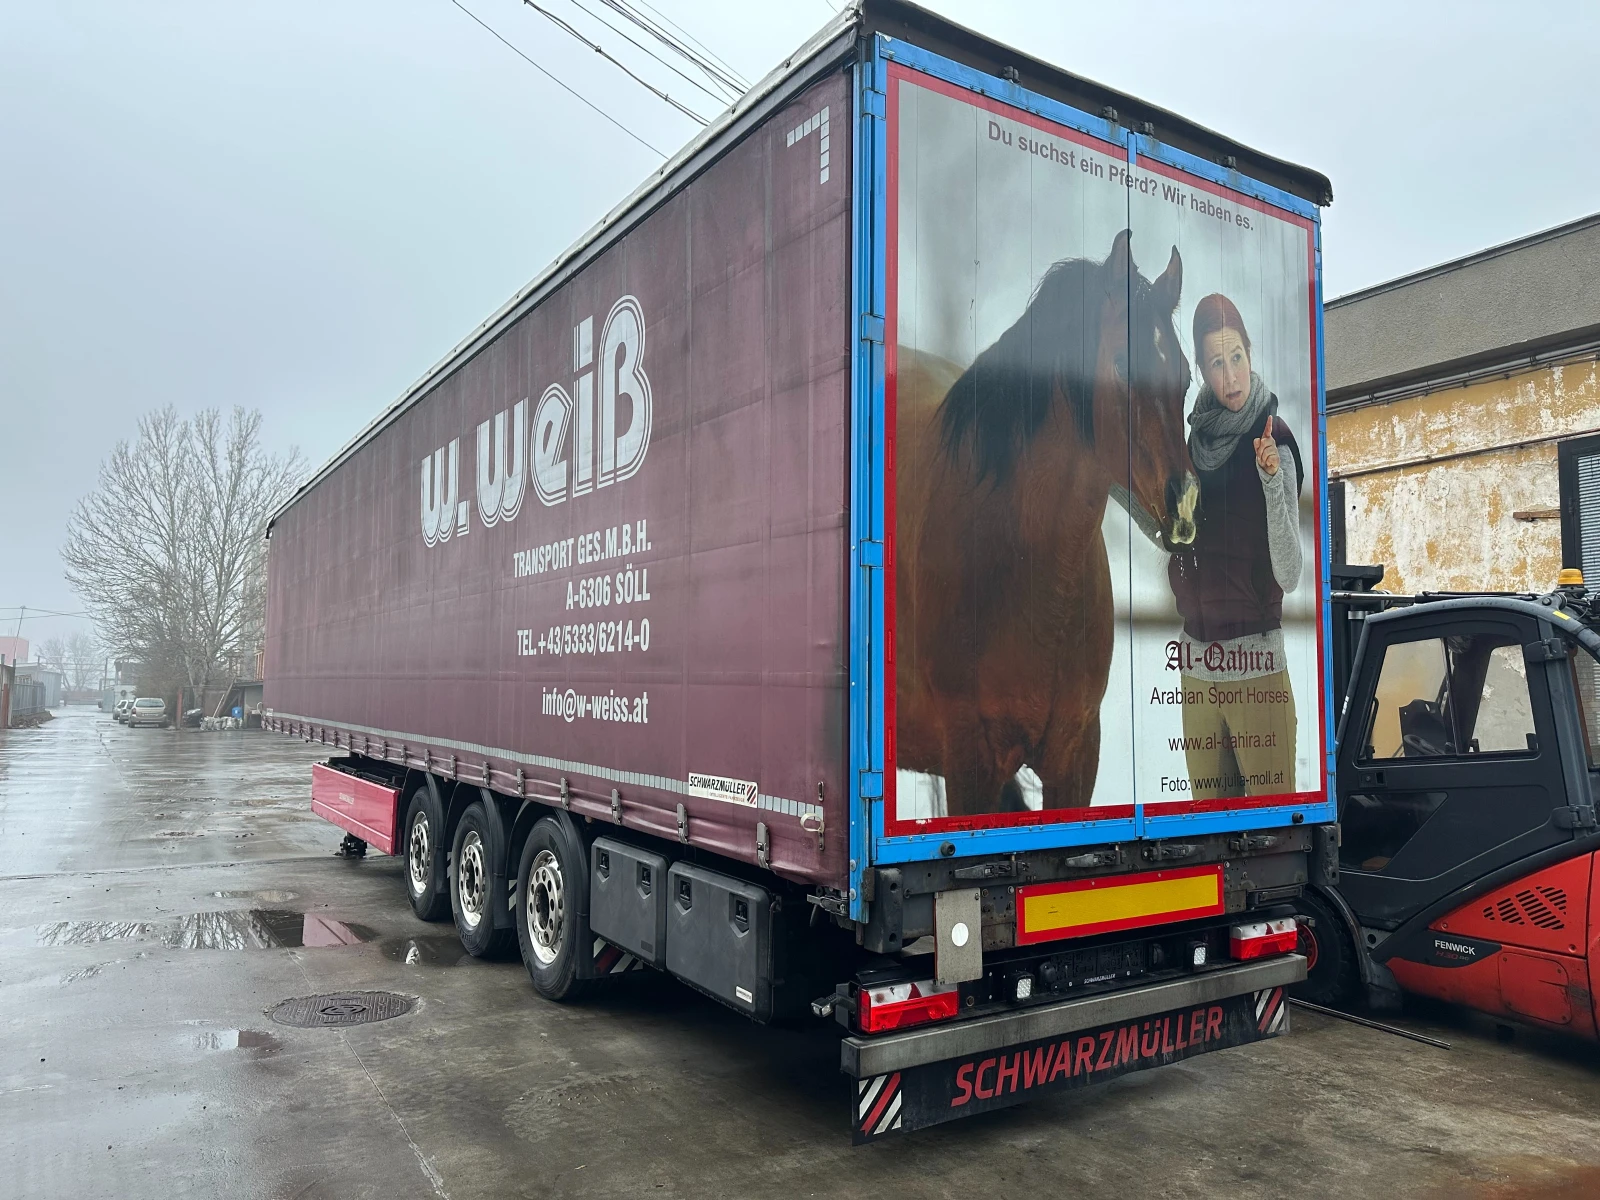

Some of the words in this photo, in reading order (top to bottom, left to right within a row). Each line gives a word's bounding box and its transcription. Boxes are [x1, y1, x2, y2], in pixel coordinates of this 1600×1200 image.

[988, 120, 1012, 146] Du
[1018, 135, 1075, 169] suchst
[1080, 157, 1104, 178] ein
[1109, 165, 1158, 196] Pferd?
[1162, 183, 1187, 206] Wir
[1191, 193, 1231, 223] haben
[1235, 212, 1254, 231] es.
[513, 538, 574, 578] TRANSPORT
[577, 519, 652, 565] GES.M.B.H.
[566, 575, 611, 610] A-6306
[615, 563, 651, 605] SÖLL
[1165, 640, 1275, 676] Al-Qahira
[542, 687, 648, 723] info@w-weiss.at
[1150, 687, 1204, 705] Arabian
[1208, 686, 1243, 708] Sport
[1247, 687, 1289, 704] Horses
[690, 776, 745, 795] SCHWARZMÜLLER
[1161, 776, 1191, 792] Foto:
[1194, 770, 1284, 791] www.julia-moll.at
[1434, 939, 1476, 956] FENWICK
[951, 1005, 1224, 1107] SCHWARZMÜLLER
